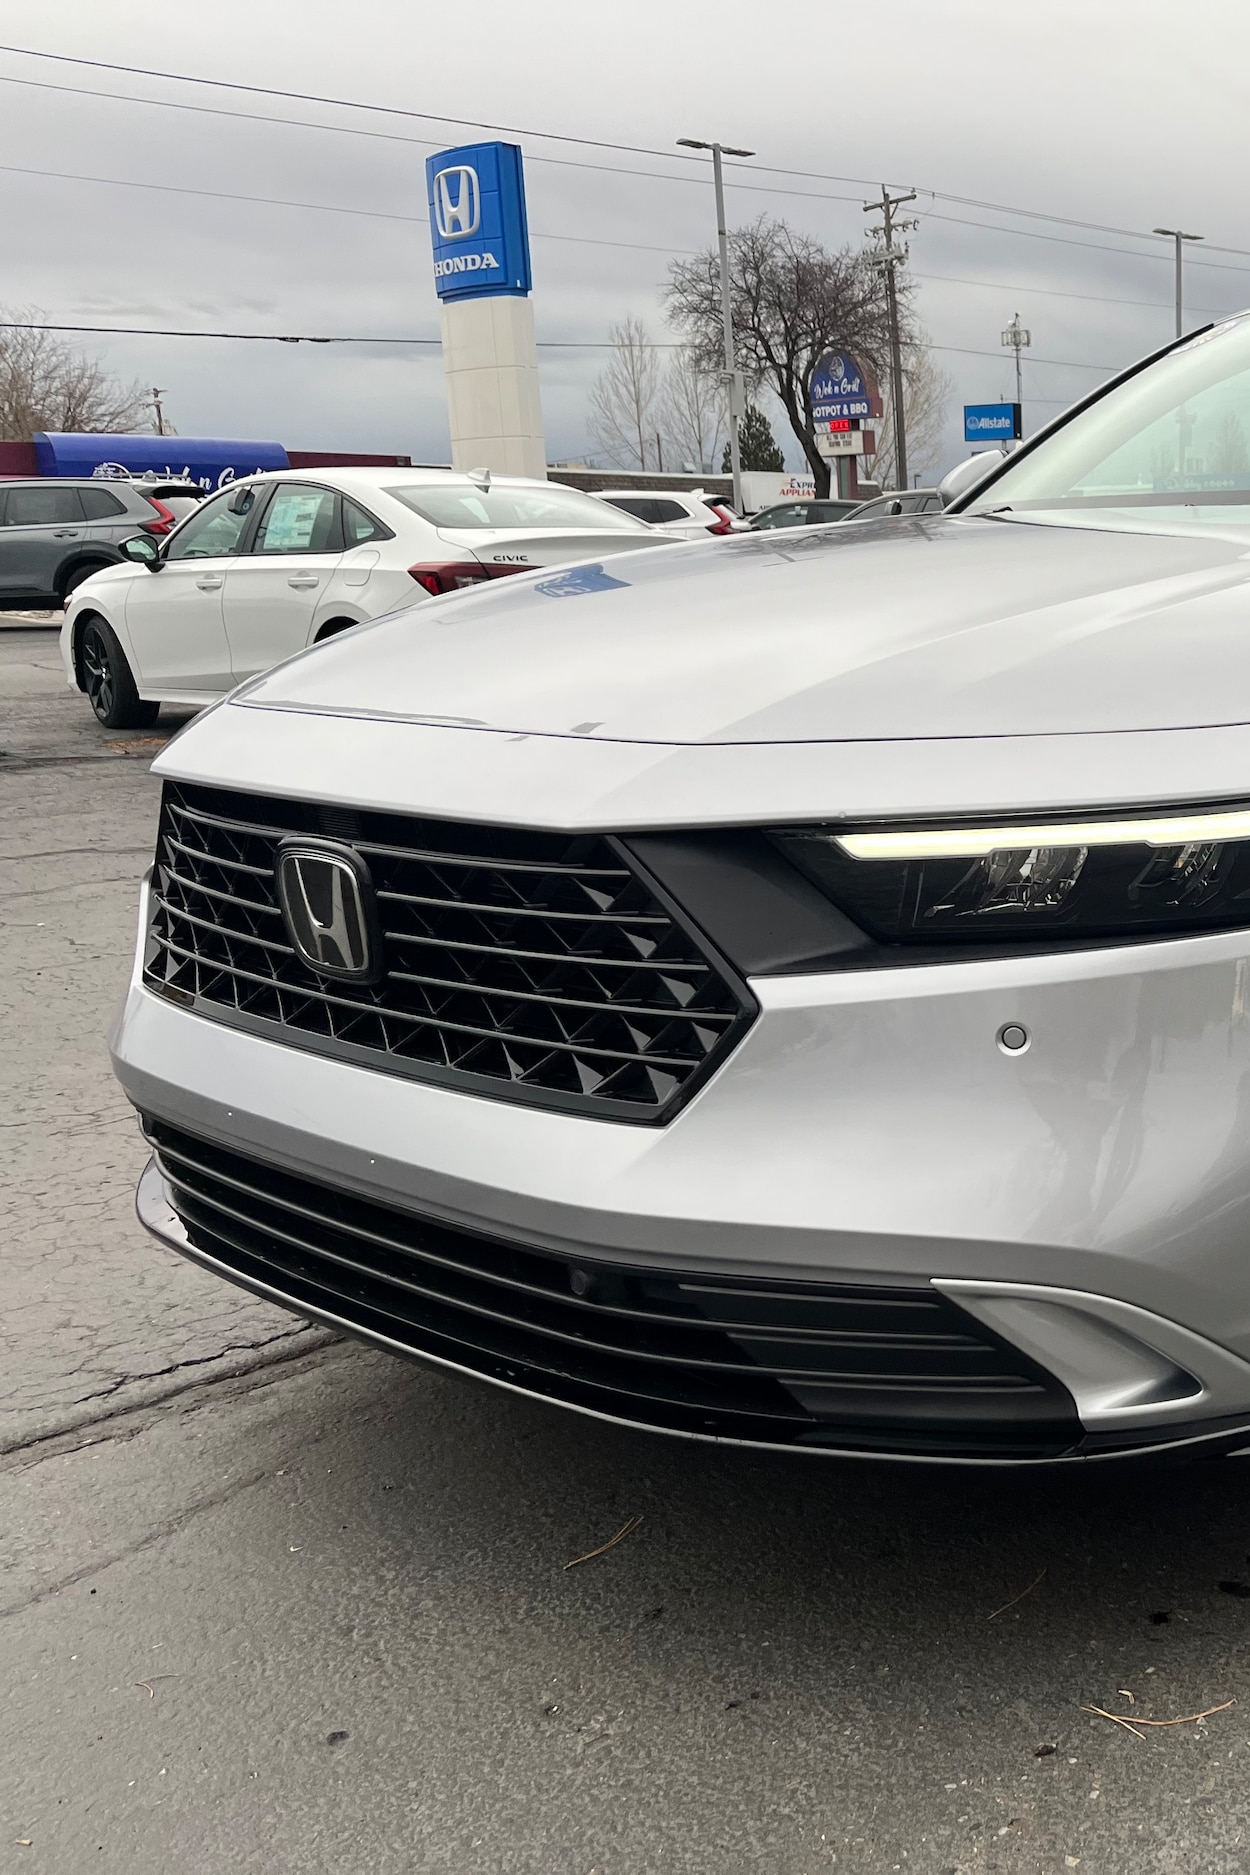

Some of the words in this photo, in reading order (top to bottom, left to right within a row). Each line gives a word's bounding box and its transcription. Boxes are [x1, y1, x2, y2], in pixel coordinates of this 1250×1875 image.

[433, 252, 500, 278] HONDA
[842, 403, 849, 415] &
[850, 402, 868, 414] BBQ
[978, 416, 1011, 429] Allstate
